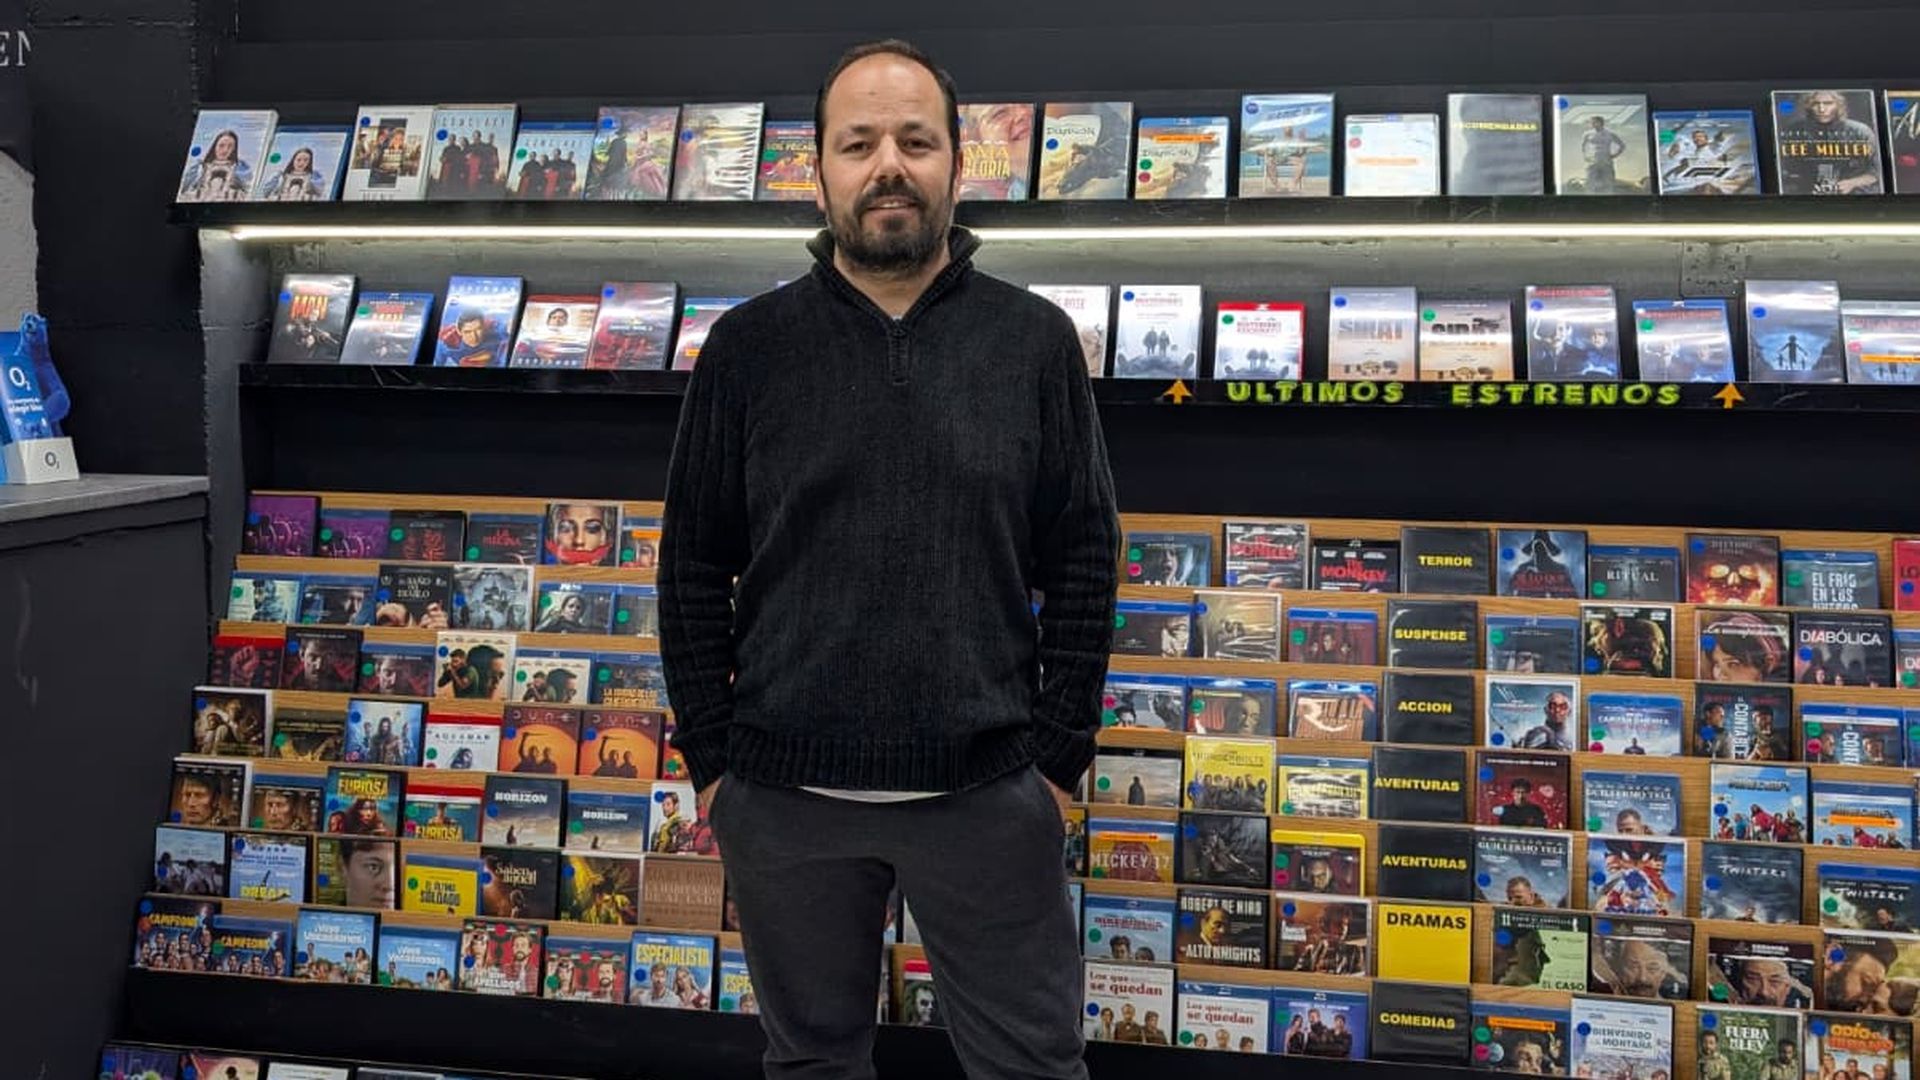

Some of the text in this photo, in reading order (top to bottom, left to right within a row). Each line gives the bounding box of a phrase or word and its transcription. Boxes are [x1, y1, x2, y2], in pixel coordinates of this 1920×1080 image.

[1781, 142, 1873, 156] LEE MILLER
[1226, 380, 1681, 406] ULTIMOS ESTRENOS
[1418, 555, 1473, 567] TERROR
[1320, 564, 1388, 582] MONKEY
[1606, 569, 1660, 583] RITUAL
[1811, 571, 1826, 587] EL
[1811, 586, 1829, 603] EN
[1394, 628, 1468, 642] SUSPENSE
[1799, 628, 1883, 647] DIABÓLICA
[1398, 700, 1453, 714] ACCION
[338, 778, 389, 796] FURIOSA
[1374, 777, 1460, 793] AVENTURAS
[494, 791, 548, 804] HORIZON
[414, 823, 464, 842] FURIOSA
[1090, 852, 1171, 870] MICKEY 17
[1382, 854, 1468, 871] AVENTURAS
[1386, 911, 1468, 930] DRAMAS
[635, 943, 711, 966] ESPECIALISTA
[1185, 943, 1262, 963] ALTO KNIGHTS
[1110, 973, 1130, 984] que
[1555, 979, 1586, 991] CASO
[1089, 981, 1164, 997] se quedan
[1186, 1010, 1254, 1026] se quedan
[1379, 1011, 1457, 1030] COMEDIAS
[1725, 1025, 1770, 1041] FUERA
